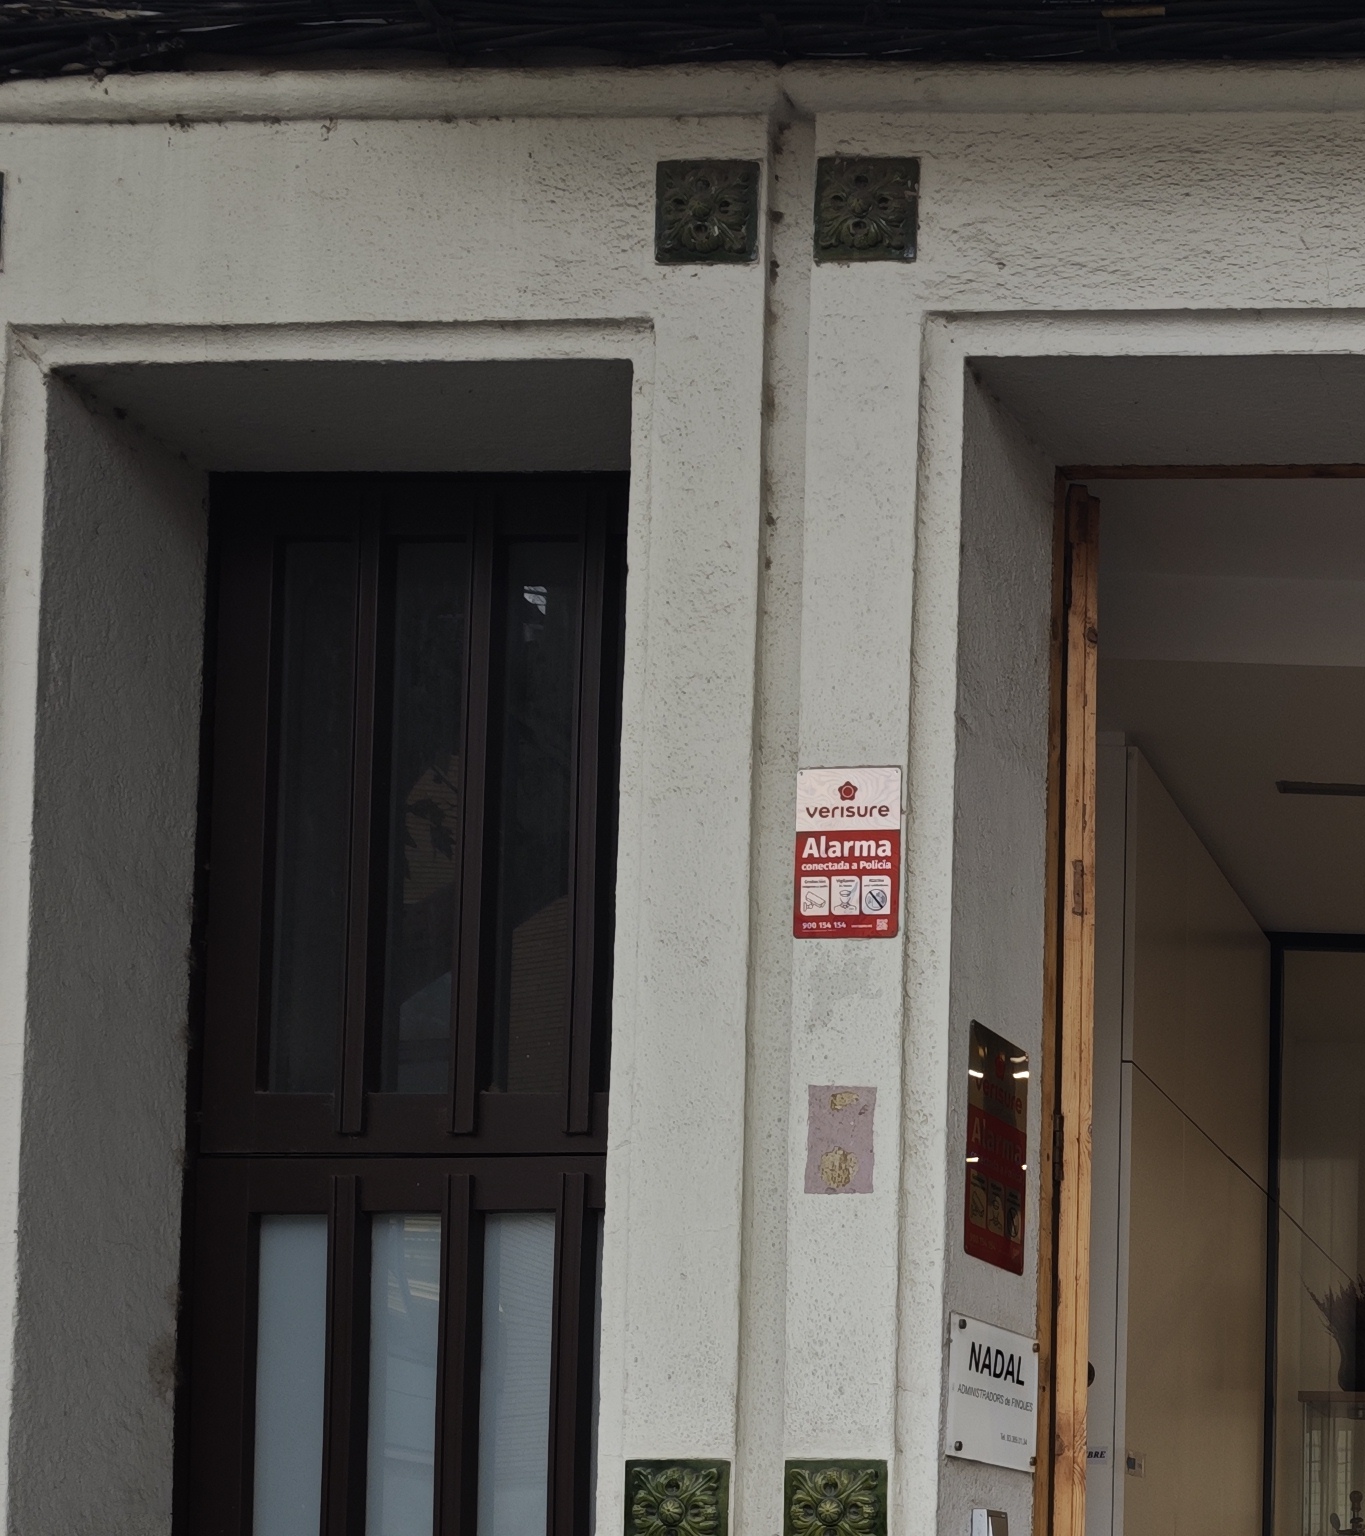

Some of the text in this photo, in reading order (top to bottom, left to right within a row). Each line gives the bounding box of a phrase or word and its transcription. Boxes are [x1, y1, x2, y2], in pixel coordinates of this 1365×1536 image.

[806, 805, 890, 818] verisure
[802, 836, 892, 858] Alarma
[801, 861, 850, 870] conectada
[859, 860, 892, 870] Policía
[976, 1077, 1023, 1115] verisure
[968, 1341, 1025, 1386] NADAL
[957, 1383, 1005, 1405] ADMINISTRADORS
[1011, 1397, 1034, 1413] FINQUES
